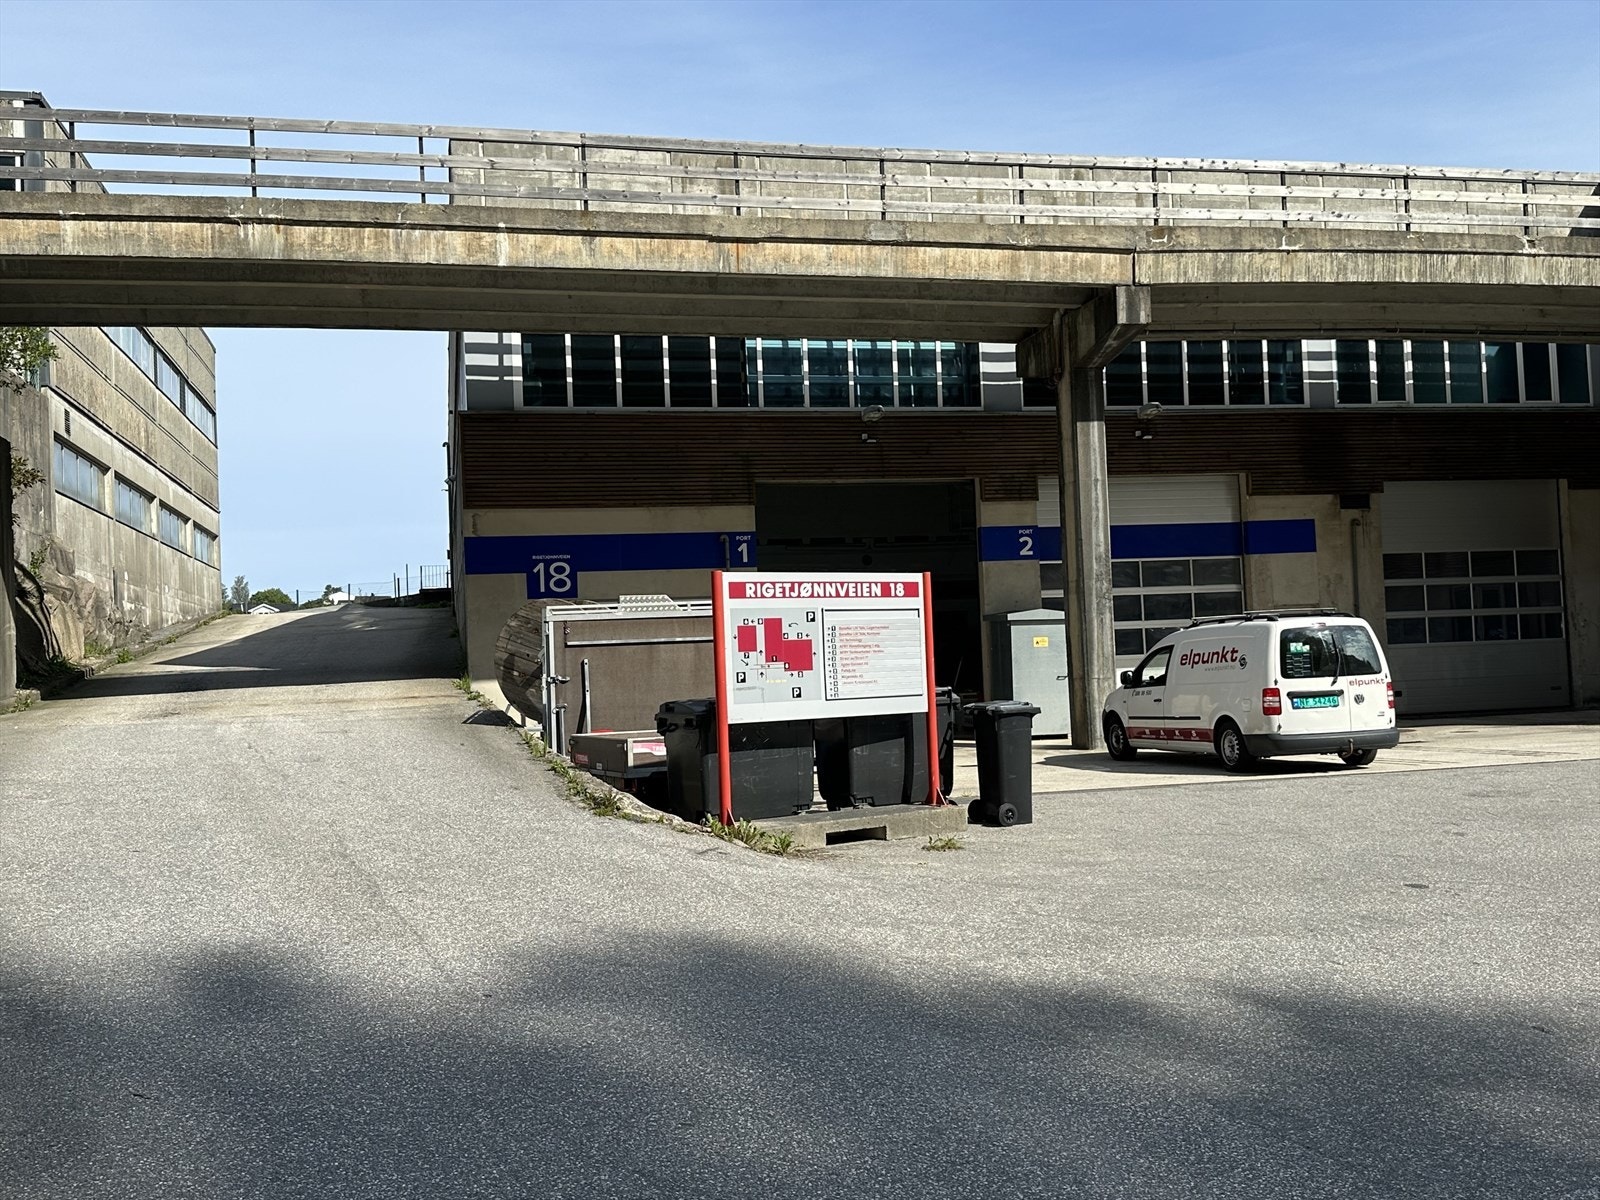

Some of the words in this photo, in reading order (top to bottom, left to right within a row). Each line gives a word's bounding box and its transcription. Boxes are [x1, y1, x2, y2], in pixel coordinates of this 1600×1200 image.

[737, 542, 748, 562] 1
[1018, 536, 1034, 556] 2
[532, 561, 571, 593] 18
[745, 582, 882, 598] RIGETJØNNVEIEN
[889, 582, 905, 597] 18
[1180, 645, 1239, 669] elpunkt
[1349, 677, 1385, 687] elpunkt
[1299, 698, 1310, 706] NF
[1313, 696, 1337, 706] 54246
